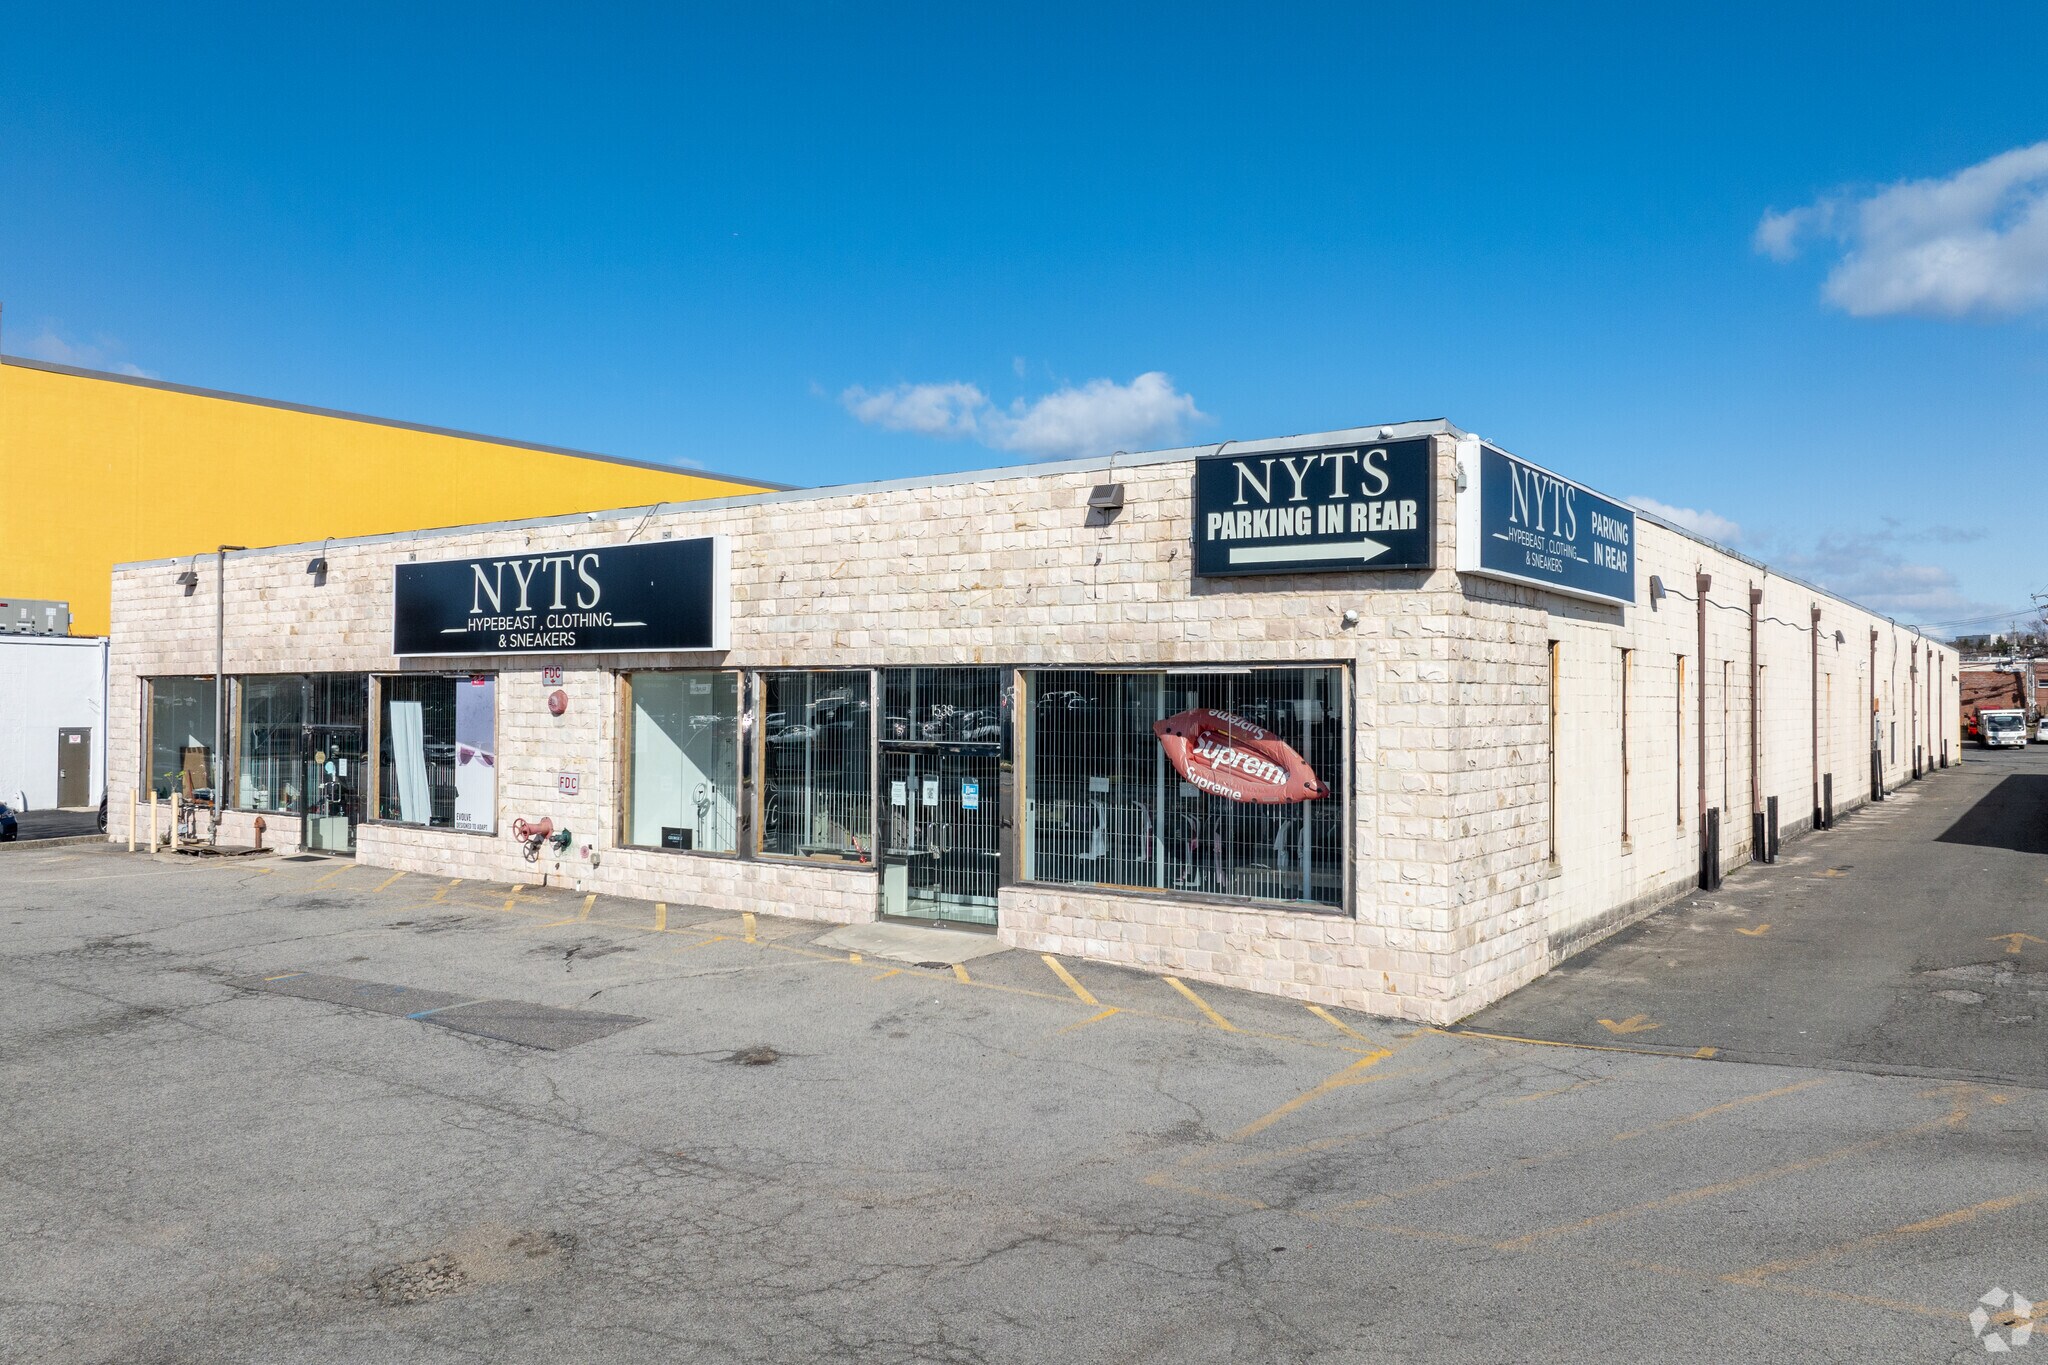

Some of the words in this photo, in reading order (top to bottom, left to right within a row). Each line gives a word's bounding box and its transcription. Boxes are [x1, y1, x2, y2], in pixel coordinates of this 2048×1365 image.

[1232, 449, 1389, 506] NYTS
[1509, 461, 1577, 542] NYTS
[1207, 505, 1312, 541] PARKING
[1317, 503, 1344, 535] IN
[1350, 500, 1417, 533] REAR
[1591, 511, 1629, 546] PARKING
[1508, 526, 1545, 551] HYPEBEAST
[1549, 539, 1577, 560] CLOTHING
[1593, 541, 1604, 567] IN
[1605, 547, 1628, 574] REAR
[1525, 551, 1531, 566] &
[1531, 552, 1563, 574] SNEAKERS
[470, 553, 600, 614] NYTS
[468, 615, 537, 632] HYPEBEAST
[546, 612, 613, 629] CLOTHING
[498, 635, 507, 648] &
[509, 632, 576, 648] SNEAKERS
[544, 667, 561, 679] FDC
[931, 704, 954, 717] 1538
[1208, 708, 1268, 741] Supreme
[560, 776, 577, 789] FDC
[1186, 765, 1242, 801] Supreme
[456, 812, 472, 822] EVOLVE
